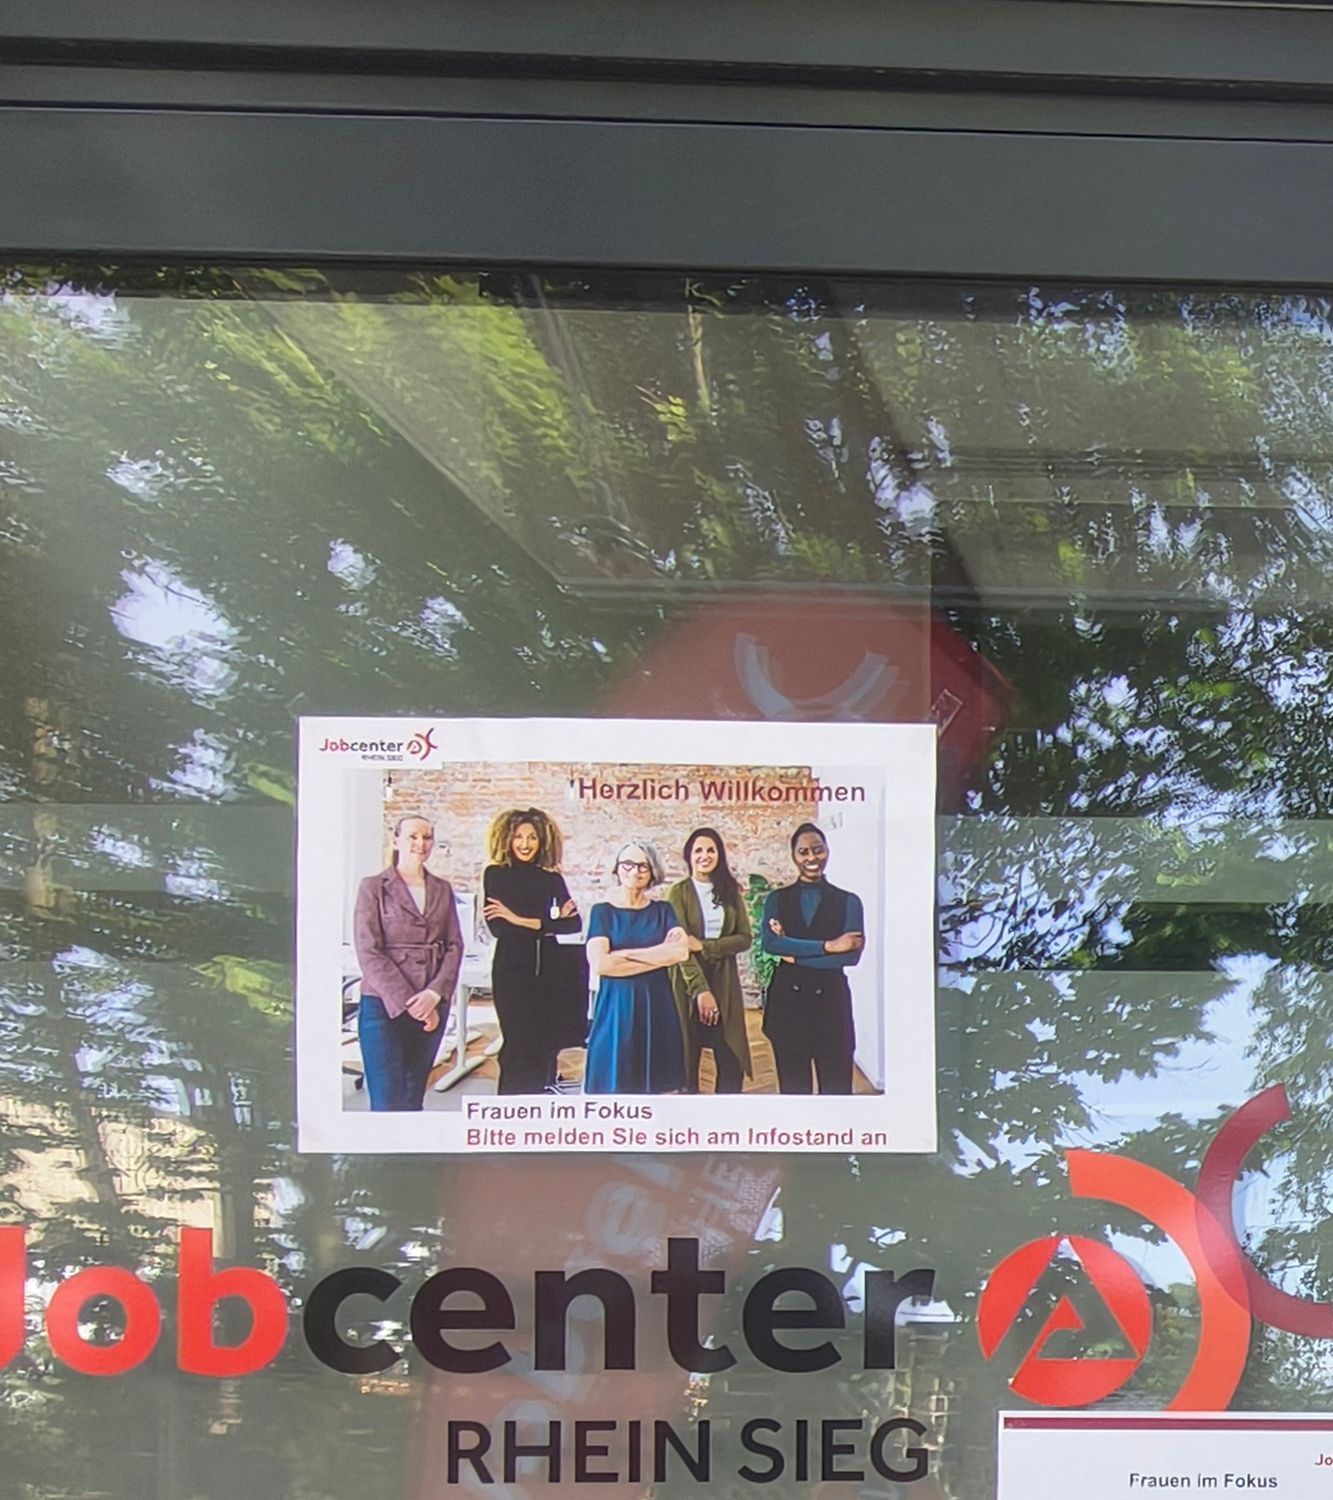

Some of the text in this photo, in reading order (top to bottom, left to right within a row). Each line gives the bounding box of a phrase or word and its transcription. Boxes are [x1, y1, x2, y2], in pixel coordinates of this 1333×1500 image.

[319, 738, 404, 752] Jobcenter
[578, 777, 865, 802] Herzlich Willkommen
[467, 1102, 653, 1120] Frauen im Fokus
[467, 1128, 887, 1147] Bitte melden Sie sich am Infostand an
[447, 1417, 930, 1484] RHEIN SIEG
[1129, 1473, 1279, 1488] Frauen im Fokus
